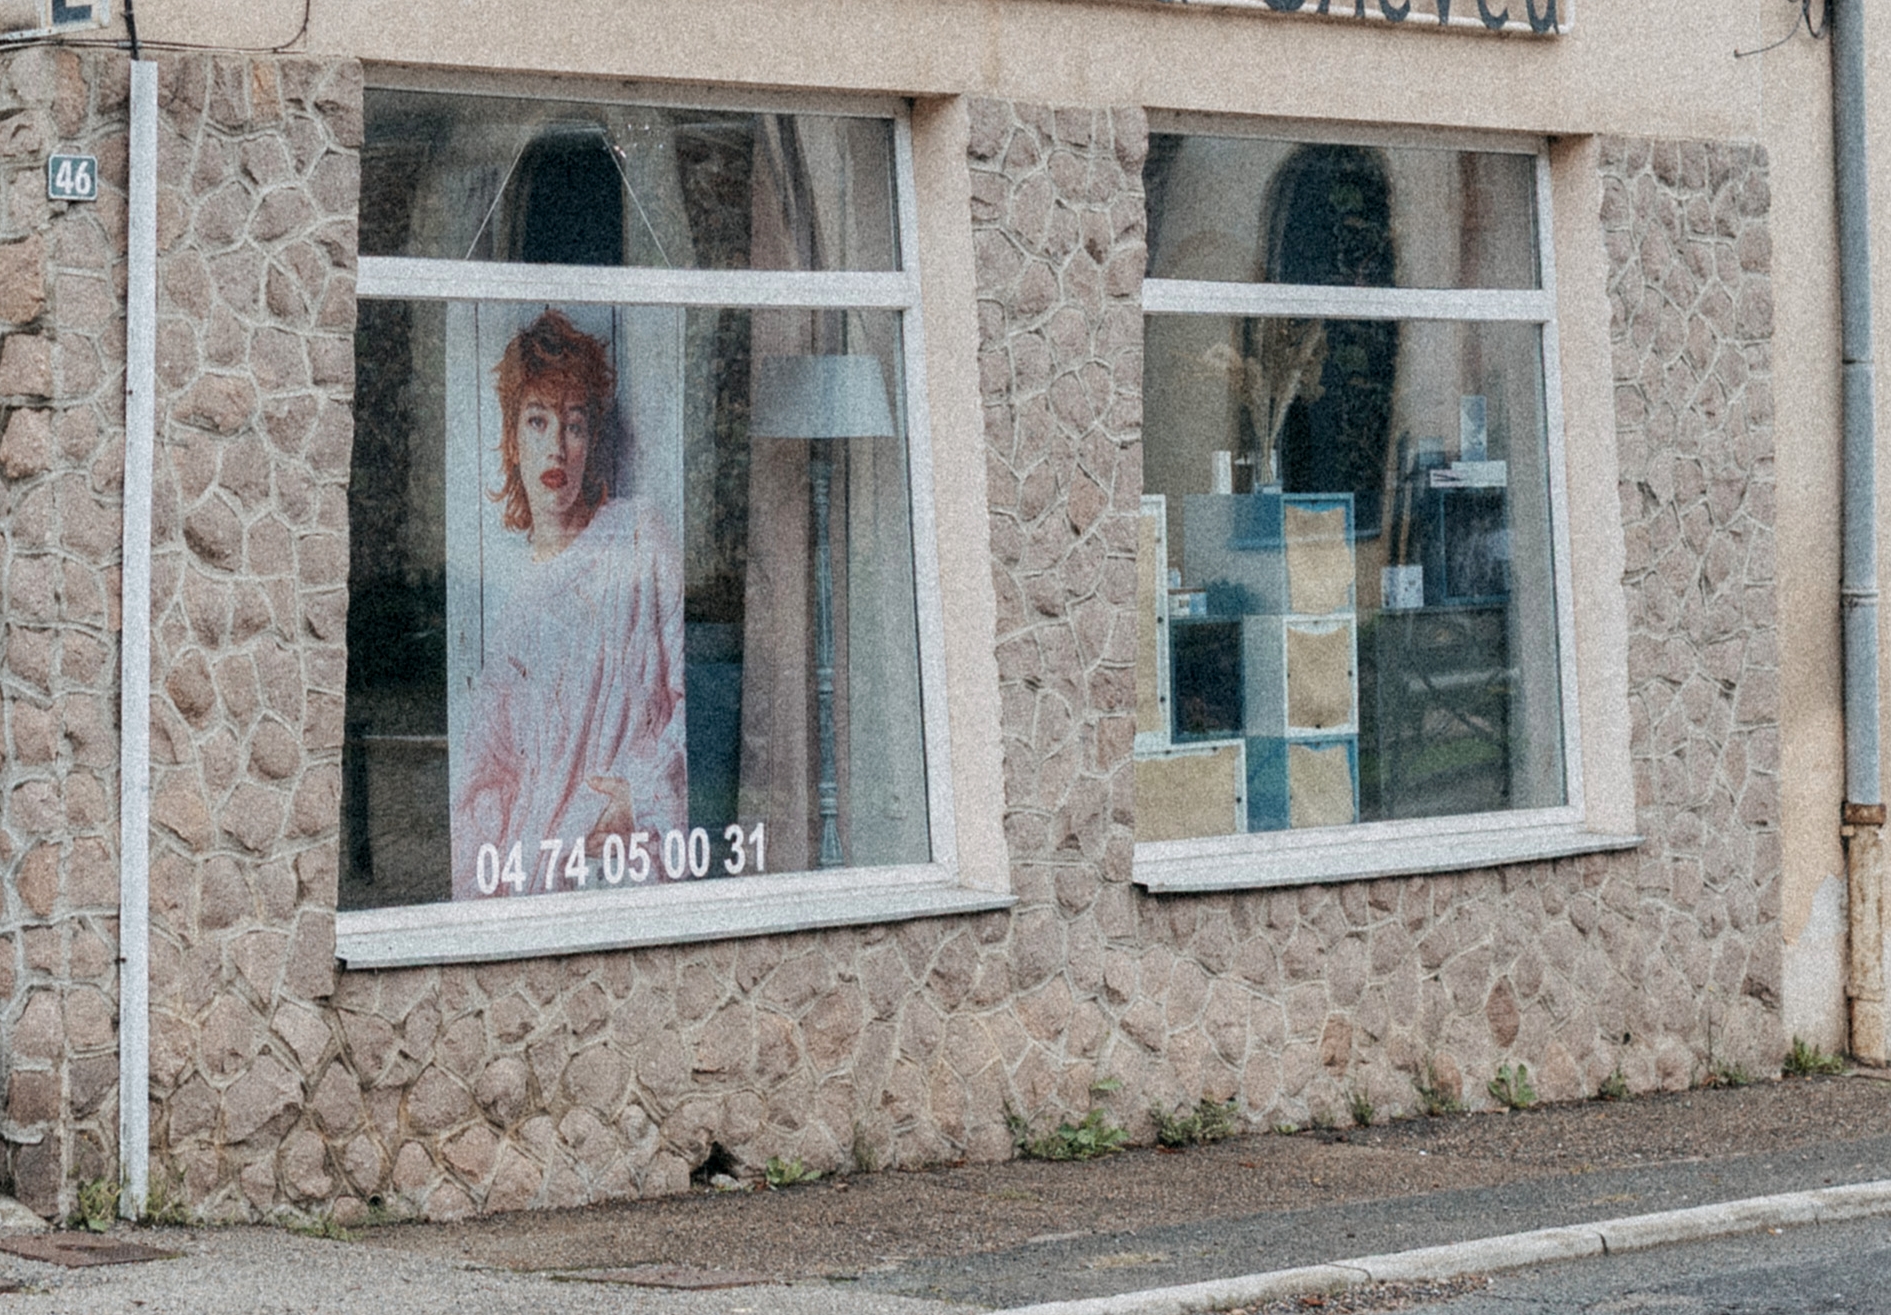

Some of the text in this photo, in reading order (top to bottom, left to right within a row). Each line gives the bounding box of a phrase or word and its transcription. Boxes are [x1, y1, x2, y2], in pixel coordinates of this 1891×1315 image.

[55, 160, 92, 195] 46
[476, 822, 765, 895] 04 74 05 00 31
